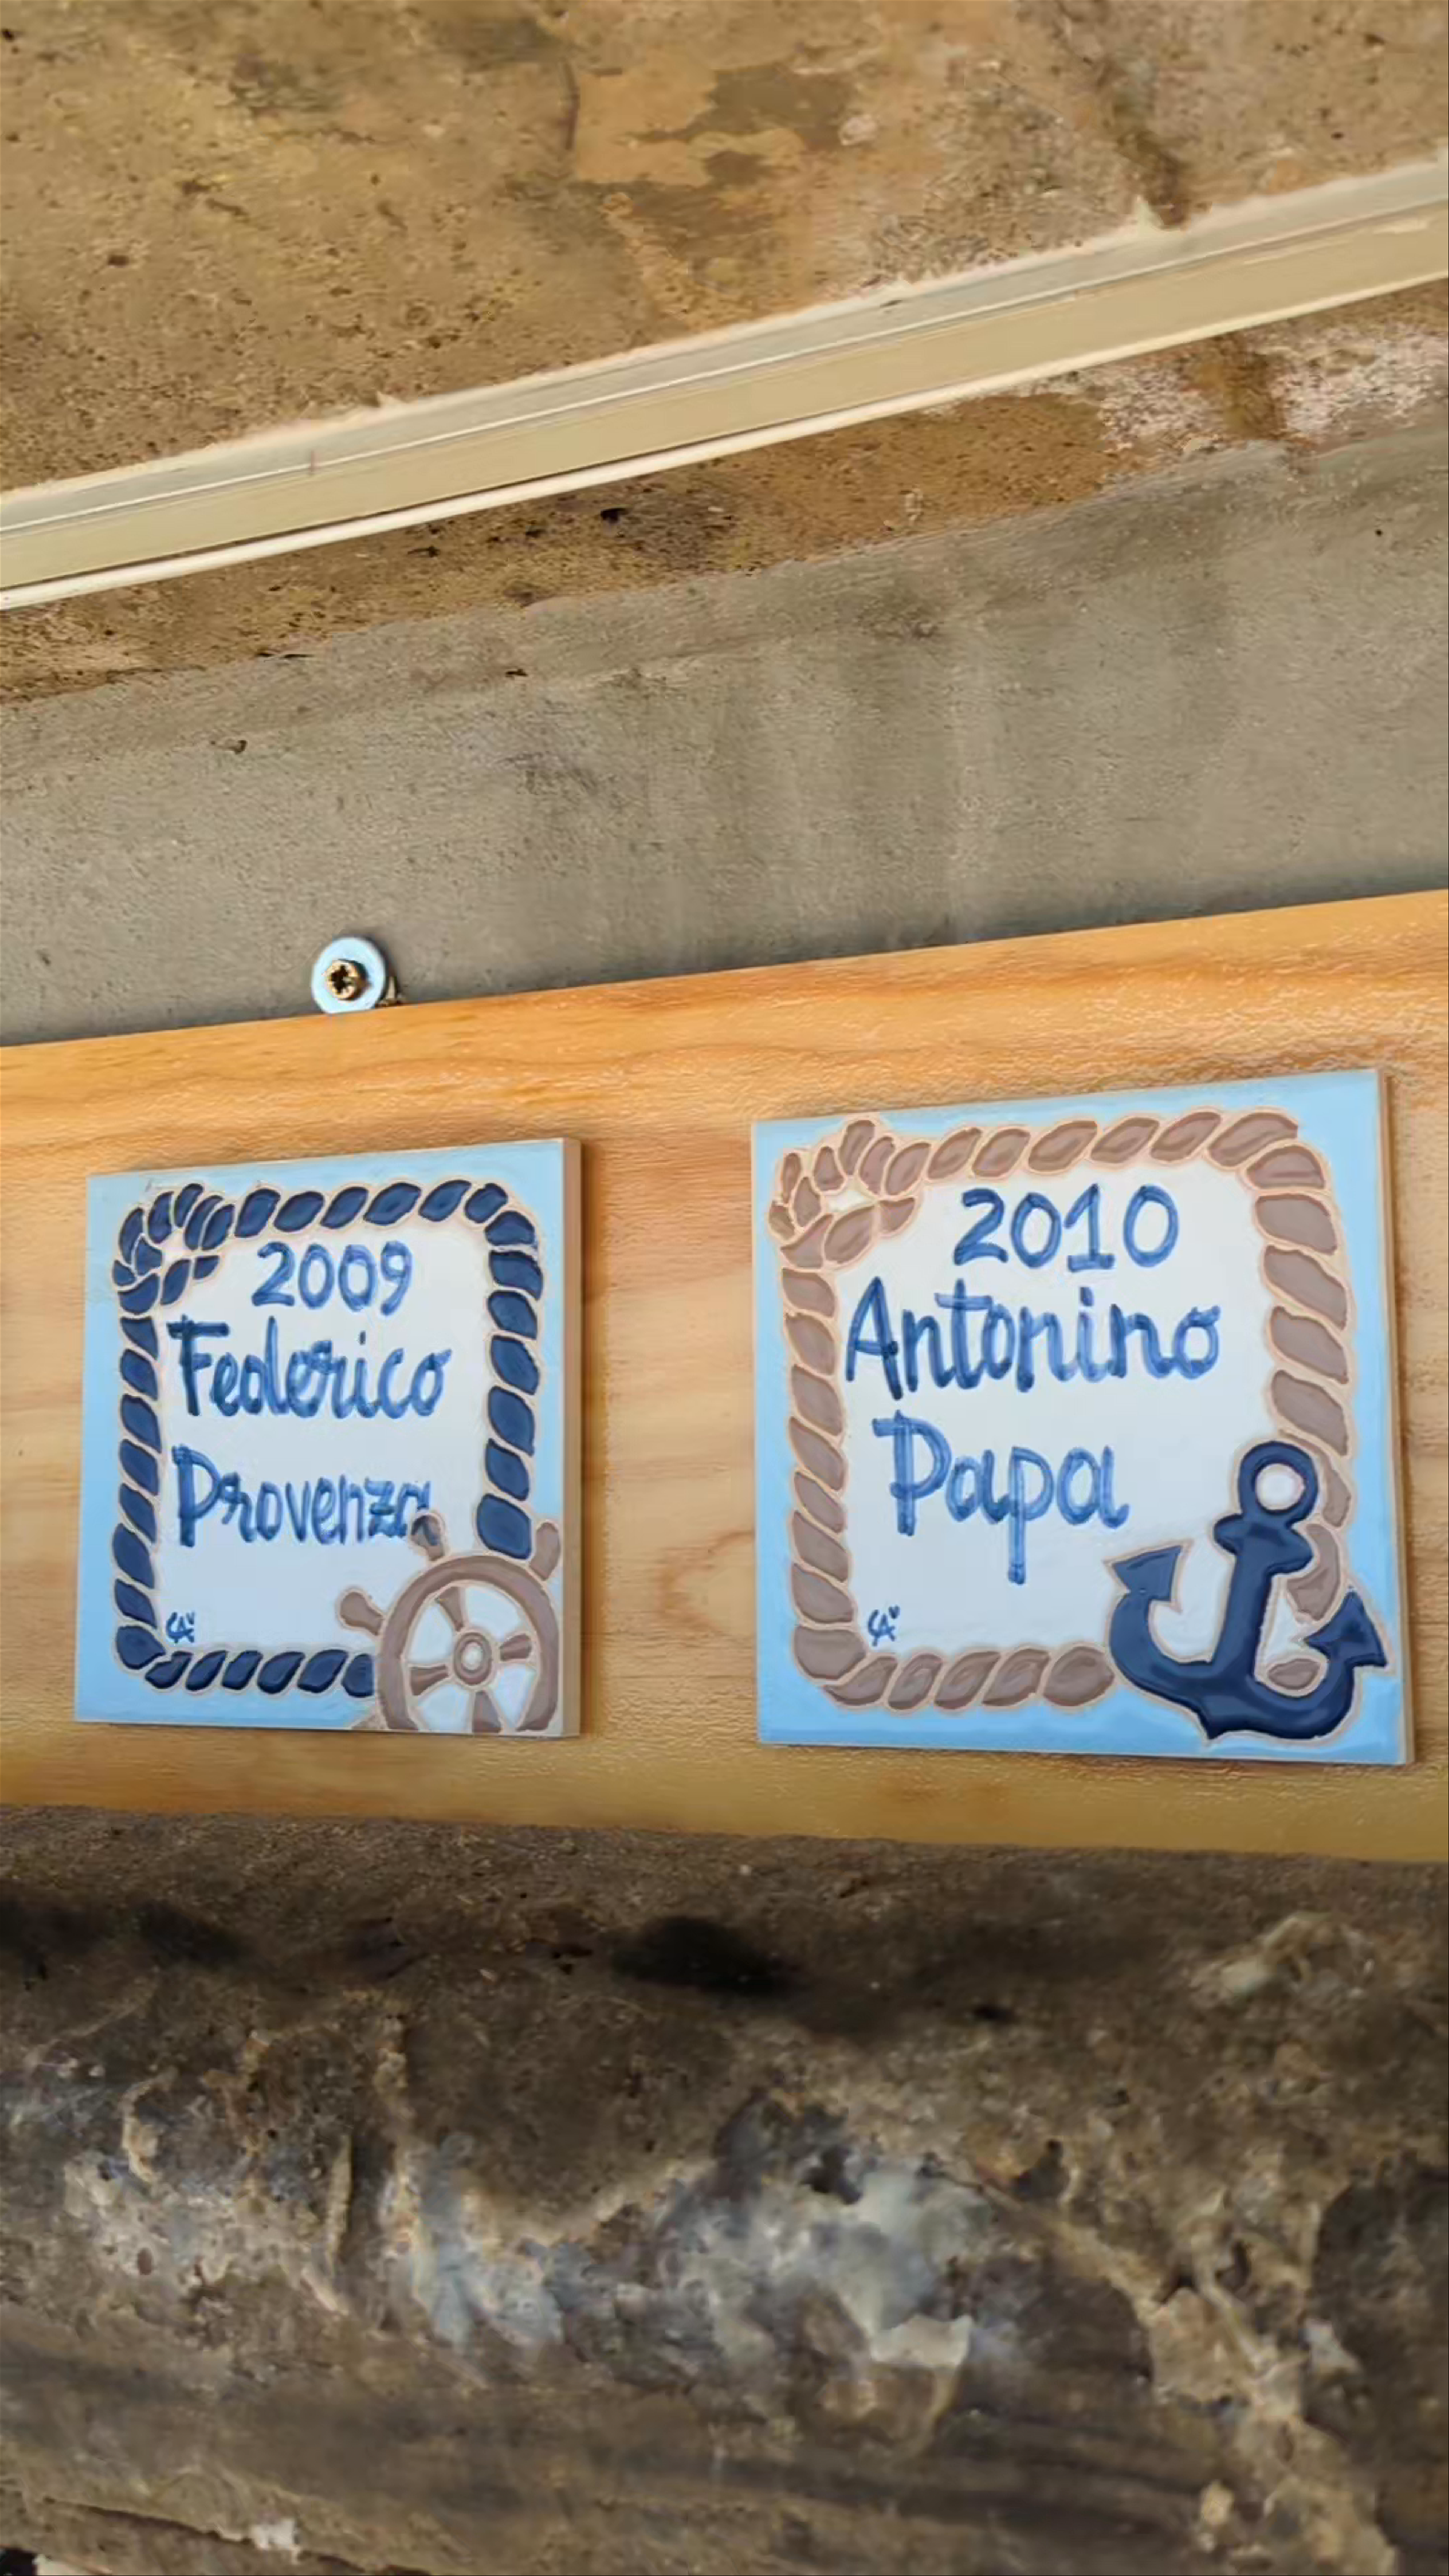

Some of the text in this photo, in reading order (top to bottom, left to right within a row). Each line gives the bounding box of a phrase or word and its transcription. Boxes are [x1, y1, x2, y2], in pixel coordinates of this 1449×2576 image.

[252, 1241, 412, 1316] 2009
[953, 1183, 1179, 1273] 2010
[167, 1315, 452, 1419] Federico
[846, 1277, 1220, 1400] Antonino
[872, 1410, 1130, 1585] Papa
